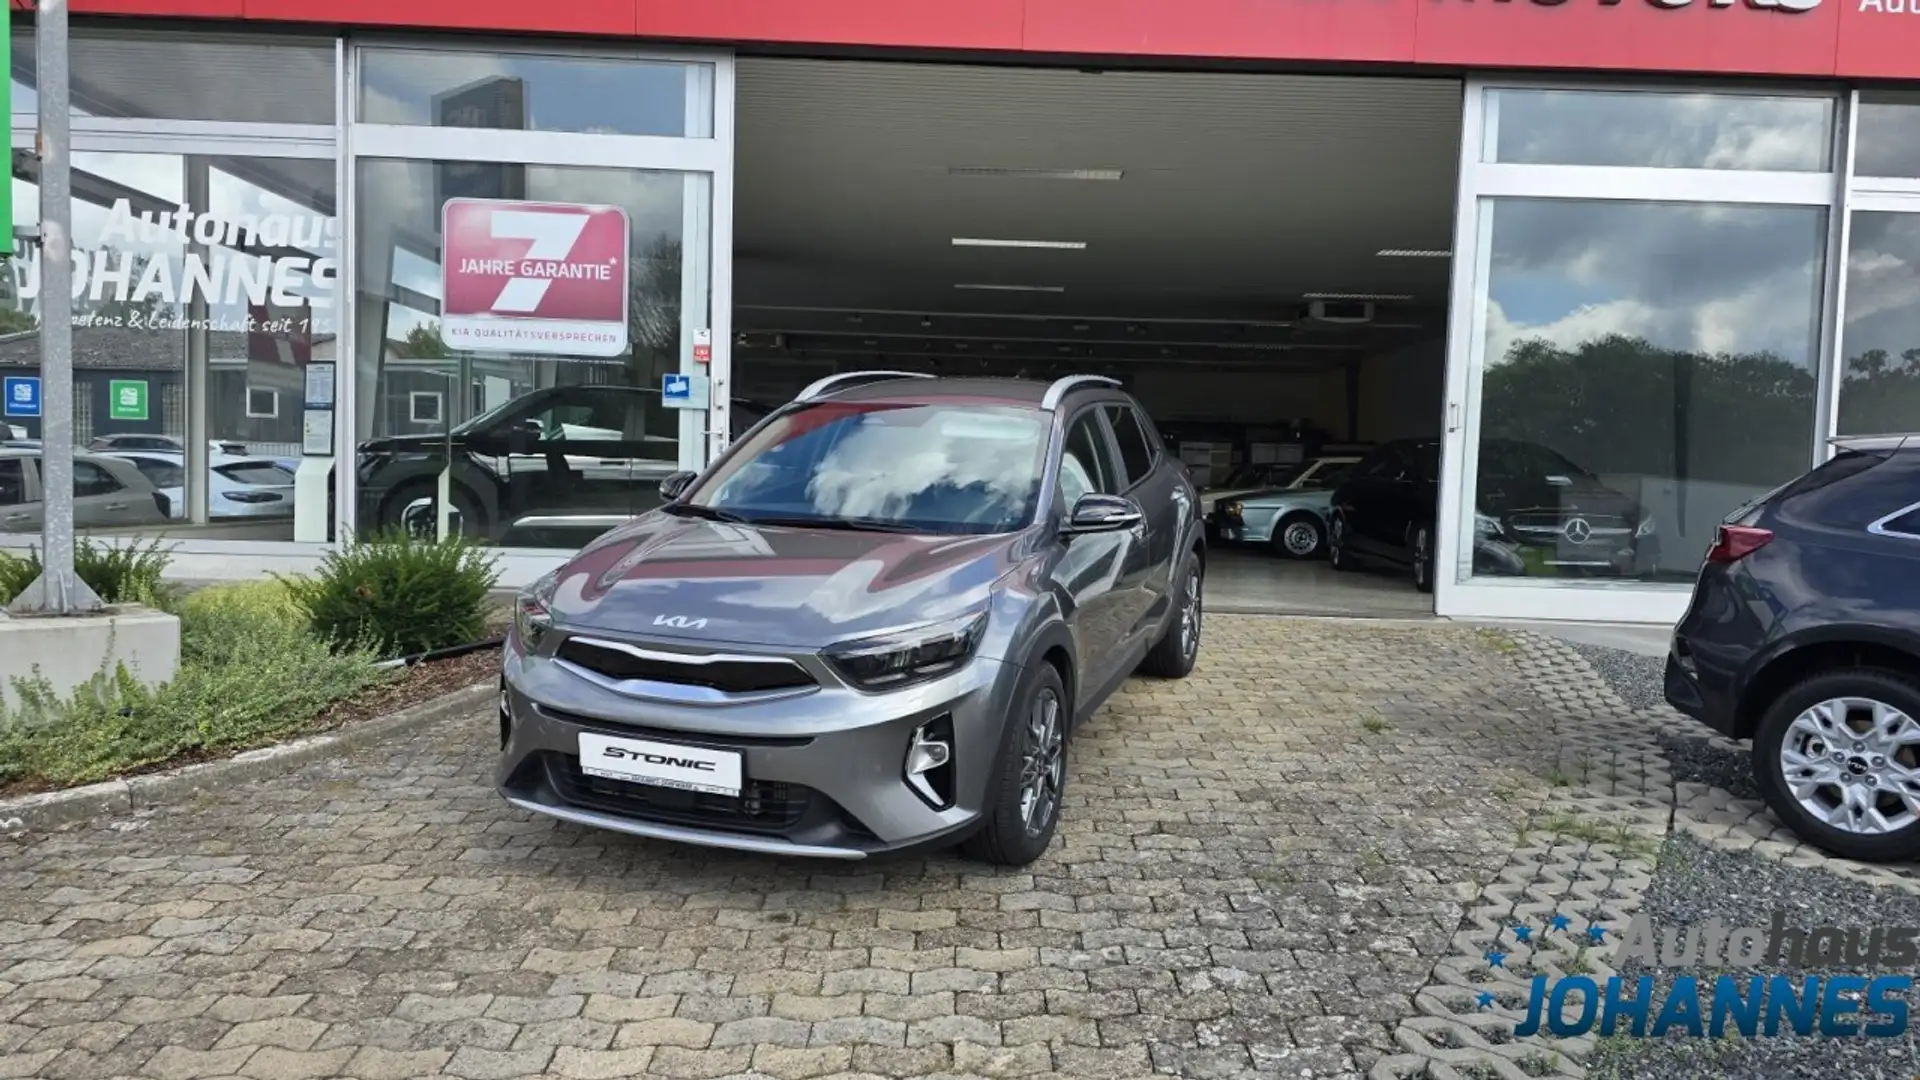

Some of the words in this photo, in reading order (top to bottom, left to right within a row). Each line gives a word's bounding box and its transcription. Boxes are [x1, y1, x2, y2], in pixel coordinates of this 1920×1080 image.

[458, 257, 516, 276] JAHRE
[490, 209, 591, 312] 7
[127, 309, 145, 330] &
[262, 315, 292, 333] seit
[451, 328, 471, 337] KIA
[474, 328, 618, 344] QUALITÄTSVERSPRECHEN
[602, 746, 717, 772] STONIC
